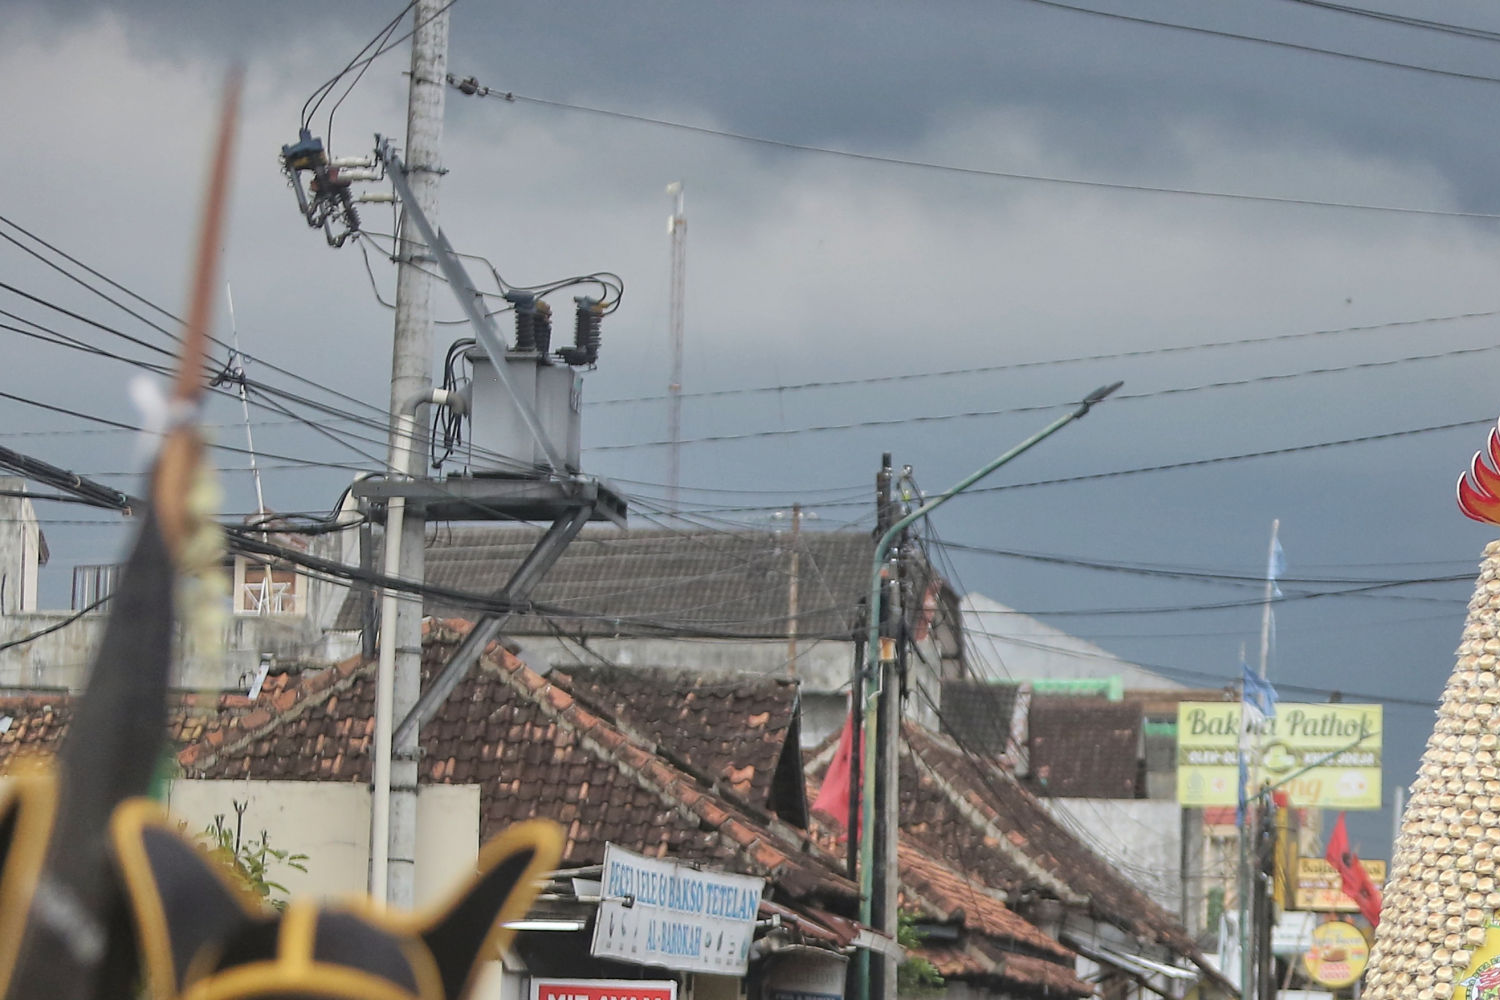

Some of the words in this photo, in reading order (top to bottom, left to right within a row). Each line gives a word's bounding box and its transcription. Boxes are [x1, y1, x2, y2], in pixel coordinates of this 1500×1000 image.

[1285, 709, 1375, 738] Pathok
[636, 869, 658, 906] LELE
[668, 873, 705, 913] BAKSO
[706, 882, 758, 920] TETELAN
